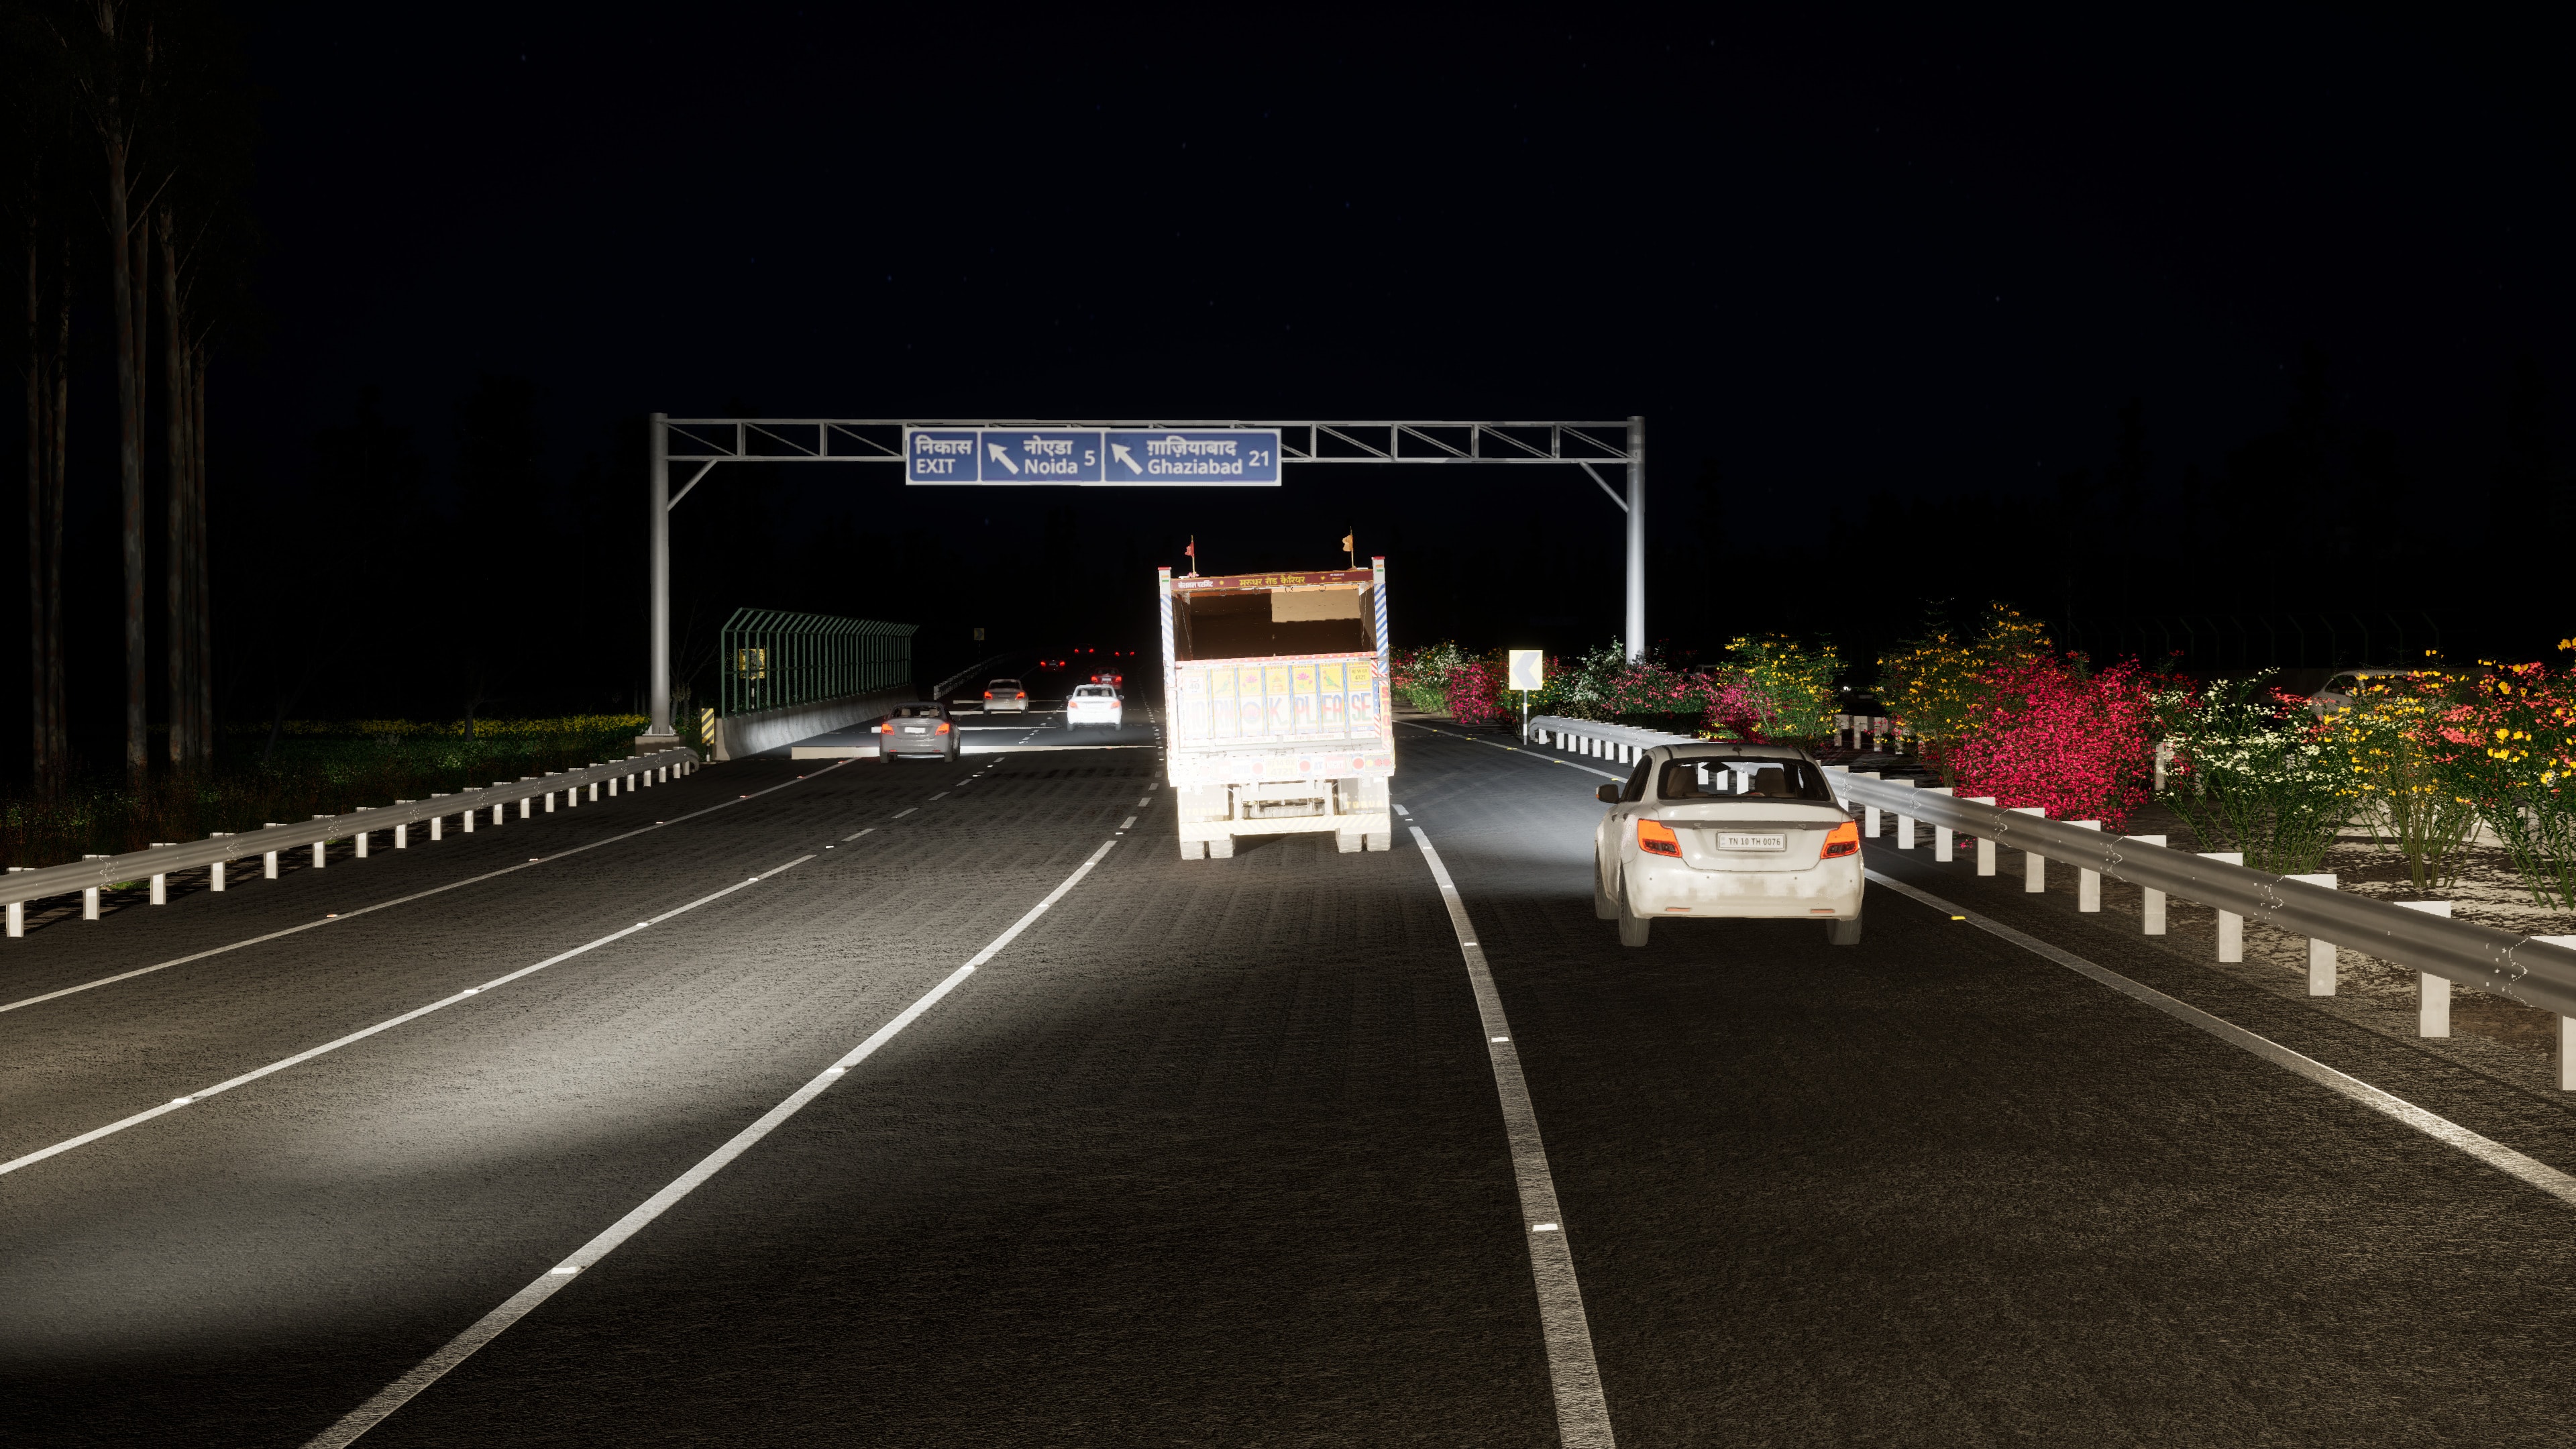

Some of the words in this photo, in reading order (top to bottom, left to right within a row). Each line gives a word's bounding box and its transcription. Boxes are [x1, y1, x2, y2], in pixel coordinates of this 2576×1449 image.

[915, 435, 973, 455] निकास
[1024, 435, 1073, 457] नोएडा
[1146, 435, 1238, 458] ग़ाज़ियाबाद
[916, 458, 956, 474] EXIT
[1024, 459, 1078, 474] Noida
[1084, 450, 1095, 467] 5
[1148, 458, 1243, 475] Ghaziabad
[1248, 450, 1269, 467] 21
[1265, 576, 1278, 585] रोड
[1763, 838, 1781, 846] 0076
